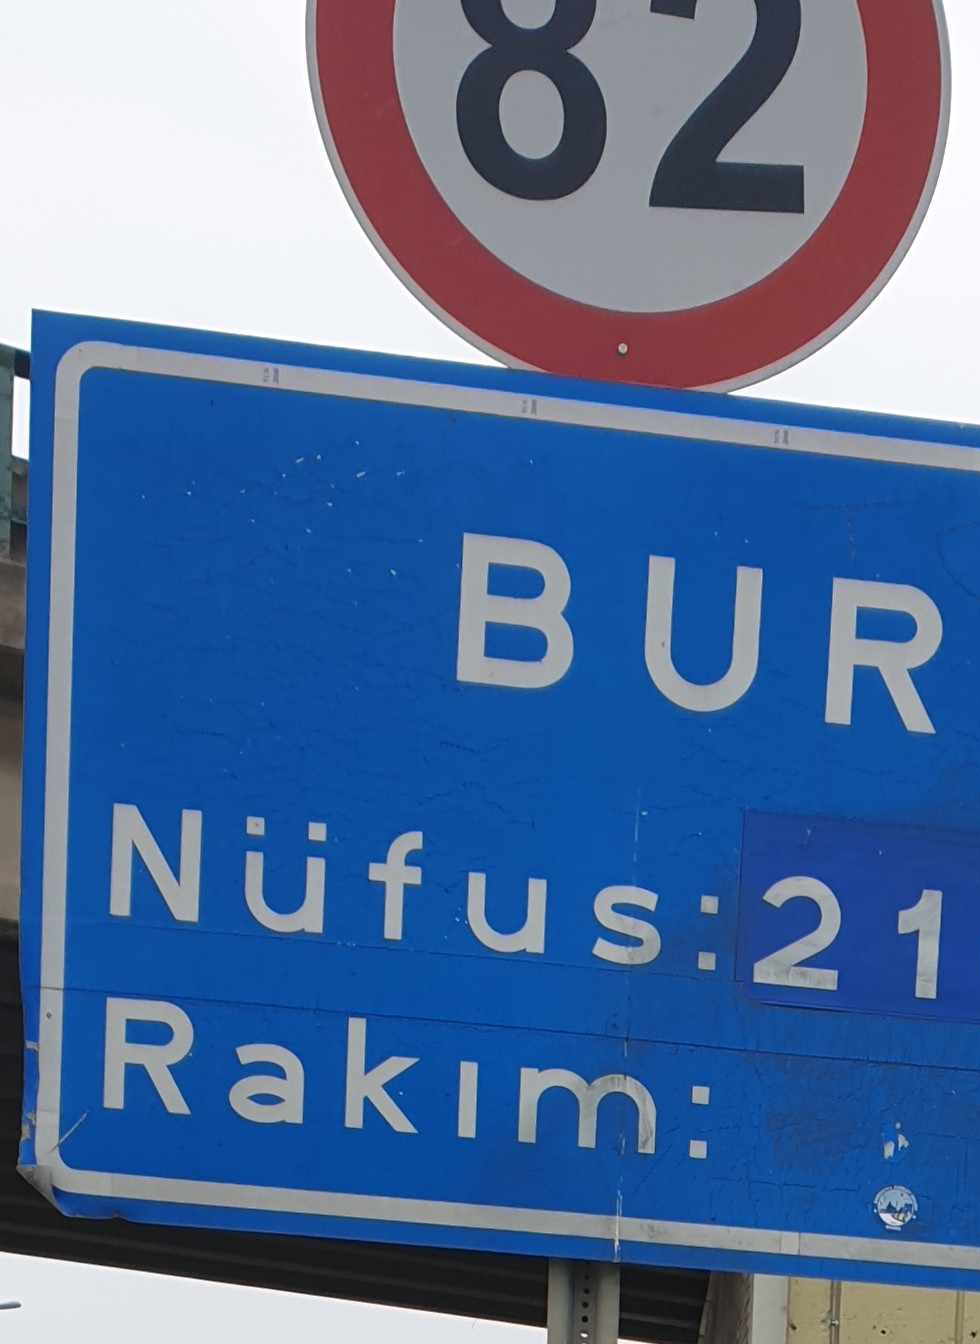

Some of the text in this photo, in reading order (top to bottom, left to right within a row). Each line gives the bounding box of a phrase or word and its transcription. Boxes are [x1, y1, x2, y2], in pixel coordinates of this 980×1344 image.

[456, 0, 805, 213] 82
[109, 804, 719, 971] Nüfus:
[103, 997, 710, 1159] Rakım:
